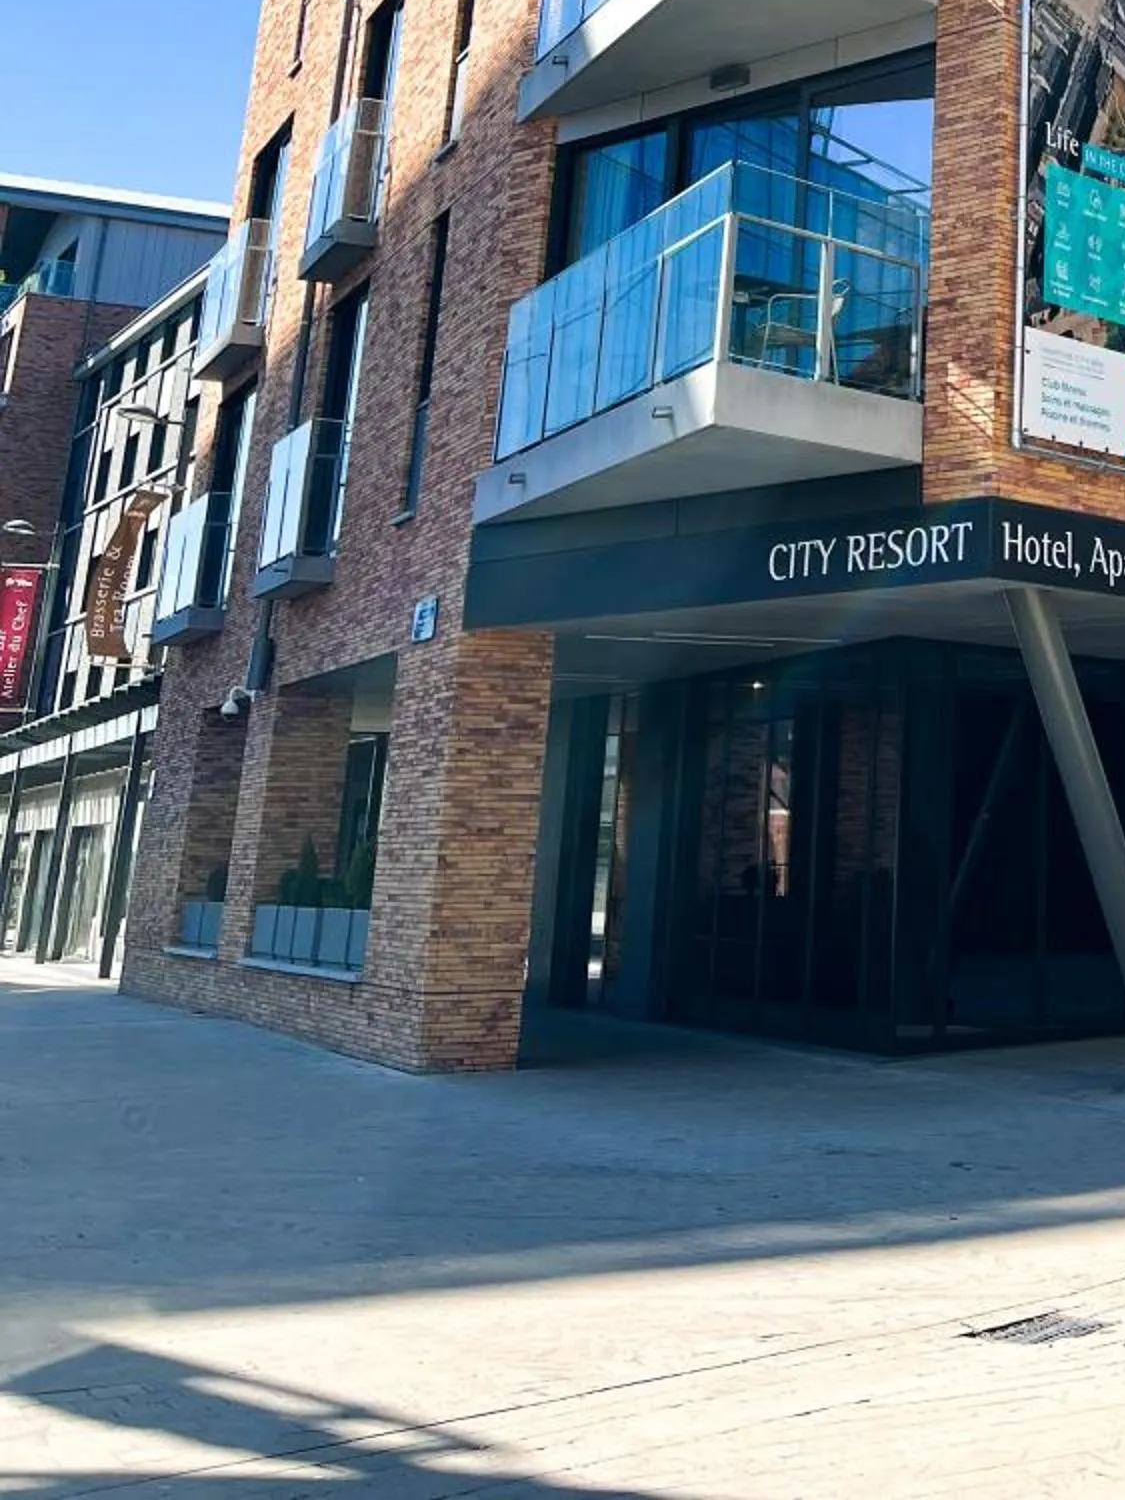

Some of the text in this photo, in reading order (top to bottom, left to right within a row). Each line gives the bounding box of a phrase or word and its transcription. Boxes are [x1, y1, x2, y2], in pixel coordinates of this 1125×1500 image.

[1045, 121, 1079, 157] Life
[1084, 149, 1097, 164] IN
[1099, 155, 1118, 173] THE
[769, 521, 973, 581] CITY RESORT
[1001, 521, 1081, 578] Hotel,
[89, 544, 123, 638] Brasserie &
[12, 600, 29, 631] Chef
[109, 610, 125, 633] Tea
[8, 635, 22, 653] du
[1, 656, 18, 699] Atelier
